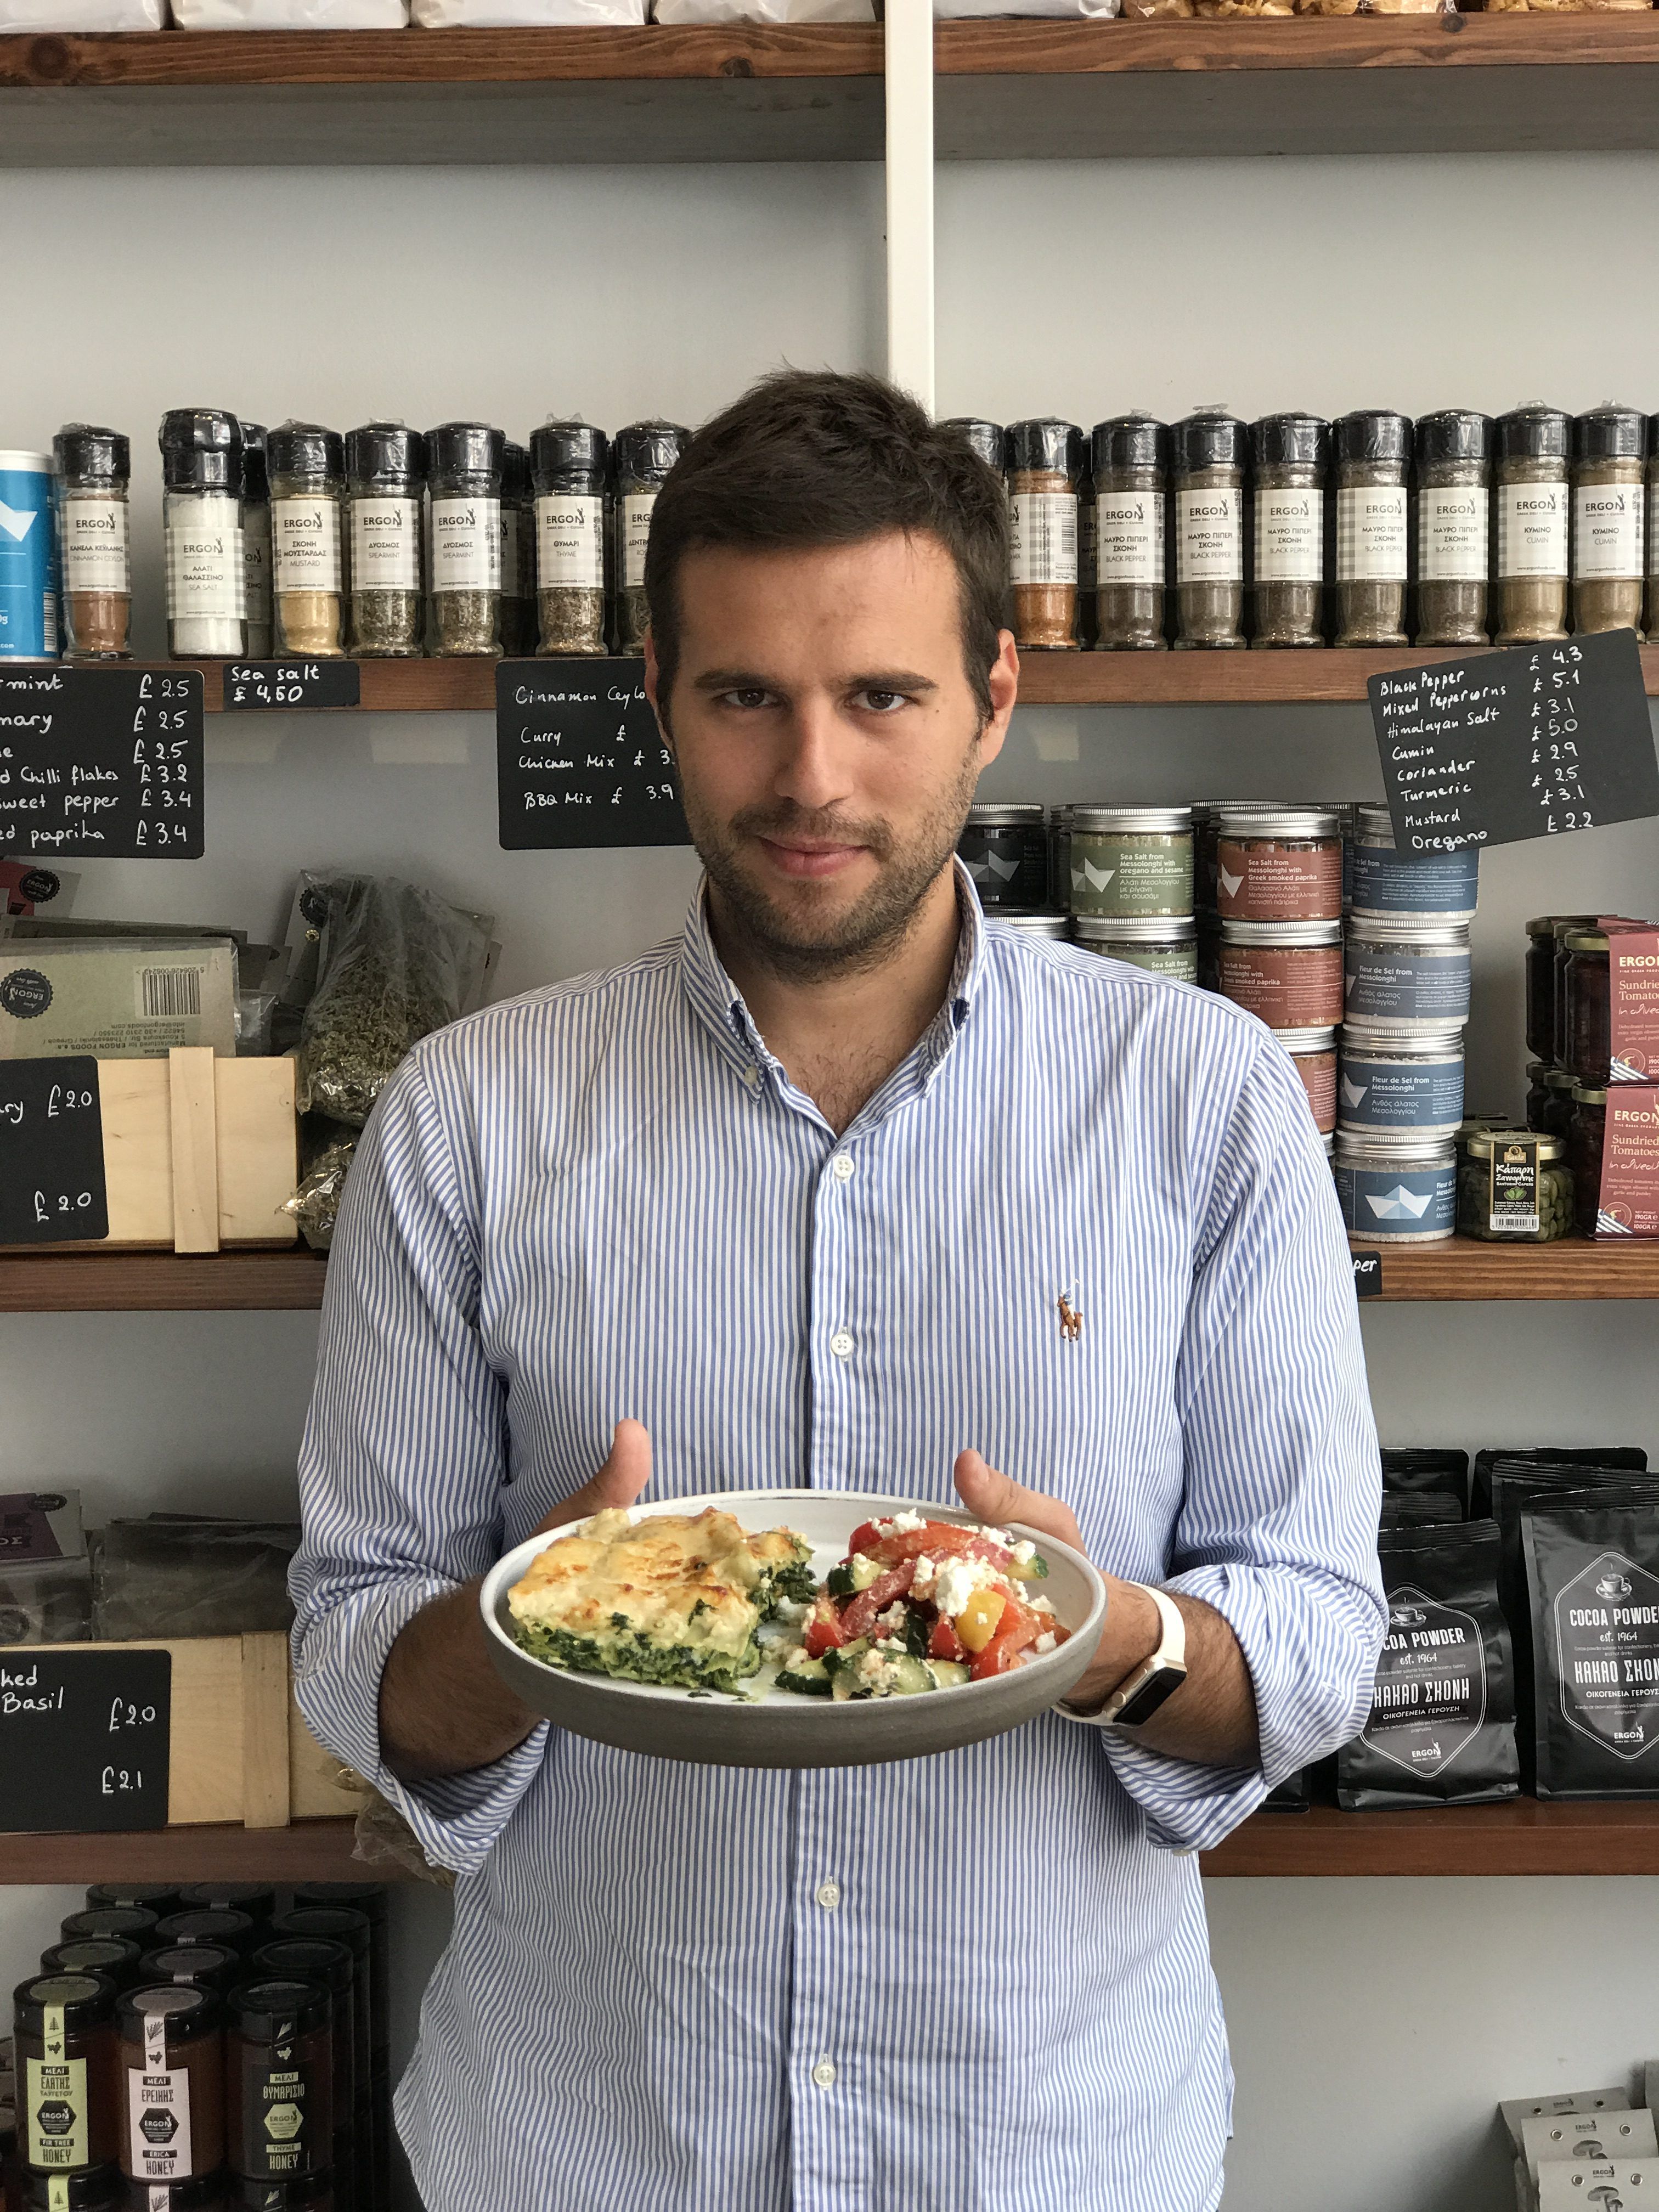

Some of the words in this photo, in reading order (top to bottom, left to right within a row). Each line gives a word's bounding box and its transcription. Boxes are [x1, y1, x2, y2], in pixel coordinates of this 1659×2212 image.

[1189, 505, 1229, 516] ERGON
[1271, 505, 1309, 516] ERGON
[1366, 503, 1402, 514] ERGON
[1437, 503, 1476, 514] ERGON
[1517, 499, 1556, 511] ERGON
[1585, 500, 1626, 512] ERGON
[364, 515, 403, 526] ERGON
[439, 515, 476, 526] ERGON
[546, 513, 585, 524] ERGON
[1106, 509, 1145, 521] ERGON
[76, 518, 116, 529] ERGON
[284, 518, 323, 529] ERGON
[184, 543, 223, 554] ERGON
[232, 667, 264, 681] Sea
[0, 674, 63, 690] mint
[1381, 681, 1417, 696] Black
[1421, 671, 1464, 691] Pepper
[516, 686, 596, 704] Cinnamon
[1384, 697, 1418, 716] Mixed
[1387, 719, 1458, 738] Himalayan
[1467, 707, 1499, 725] Salt
[521, 727, 561, 746] Curry
[1392, 746, 1434, 760] Cumin
[587, 754, 614, 767] Mix
[21, 766, 60, 783] Chilli
[72, 765, 118, 785] flakes
[1398, 760, 1475, 781] Coriander
[1401, 782, 1471, 802] Turmeric
[0, 794, 46, 809] weet
[65, 795, 119, 815] pepper
[524, 792, 557, 809] BBQ
[565, 792, 592, 804] Mix
[1406, 809, 1460, 827] Mustard
[31, 820, 104, 848] paprika
[1412, 831, 1487, 851] Oregano
[1372, 1084, 1415, 1092] Messolonghi
[1612, 1134, 1659, 1146] Sundried
[1570, 1608, 1609, 1627] COCOA
[1613, 1605, 1659, 1626] POWDE
[1412, 1627, 1466, 1648] POWDER
[1600, 1630, 1614, 1643] est.
[1617, 1631, 1638, 1641] 1964
[1400, 1653, 1414, 1666] est.
[1417, 1652, 1437, 1663] 1964
[2, 1686, 63, 1713] Basil
[1614, 1729, 1644, 1740] ERGON
[1412, 1746, 1442, 1758] ERGON
[144, 2119, 172, 2128] ERGON
[43, 2149, 71, 2163] HONEY
[269, 2153, 298, 2170] HONEY
[146, 2160, 174, 2175] HONEY
